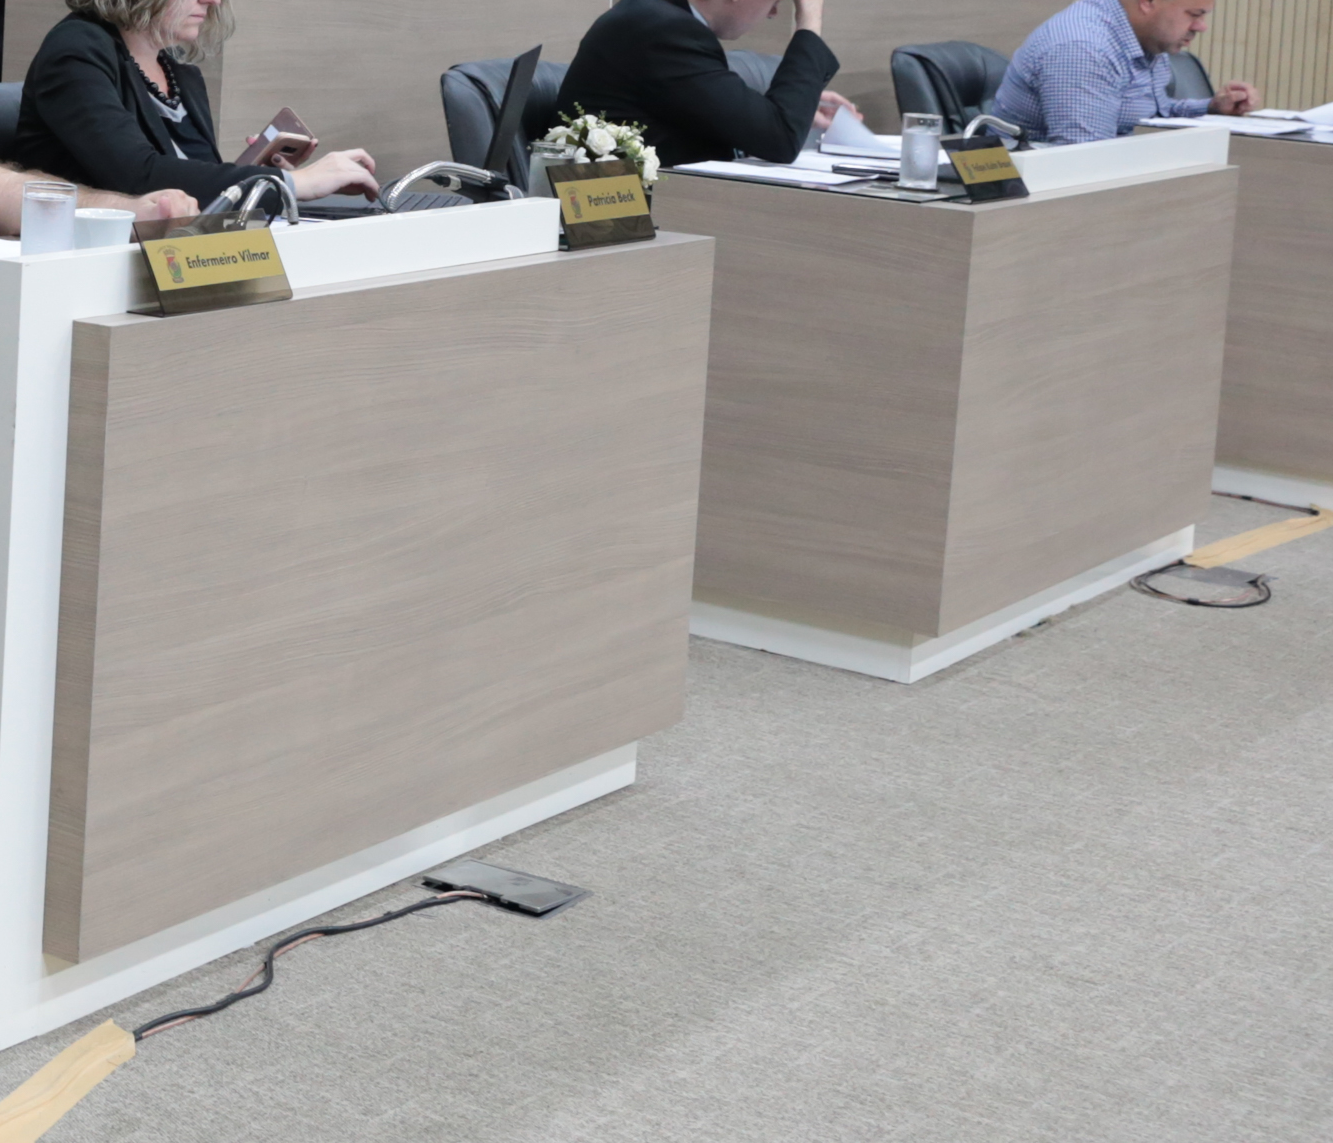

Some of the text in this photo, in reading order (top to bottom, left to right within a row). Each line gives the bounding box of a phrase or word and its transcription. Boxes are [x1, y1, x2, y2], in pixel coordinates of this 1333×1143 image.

[586, 189, 636, 207] Patricia Beck
[185, 249, 271, 269] Enfermeiro Vilmar
